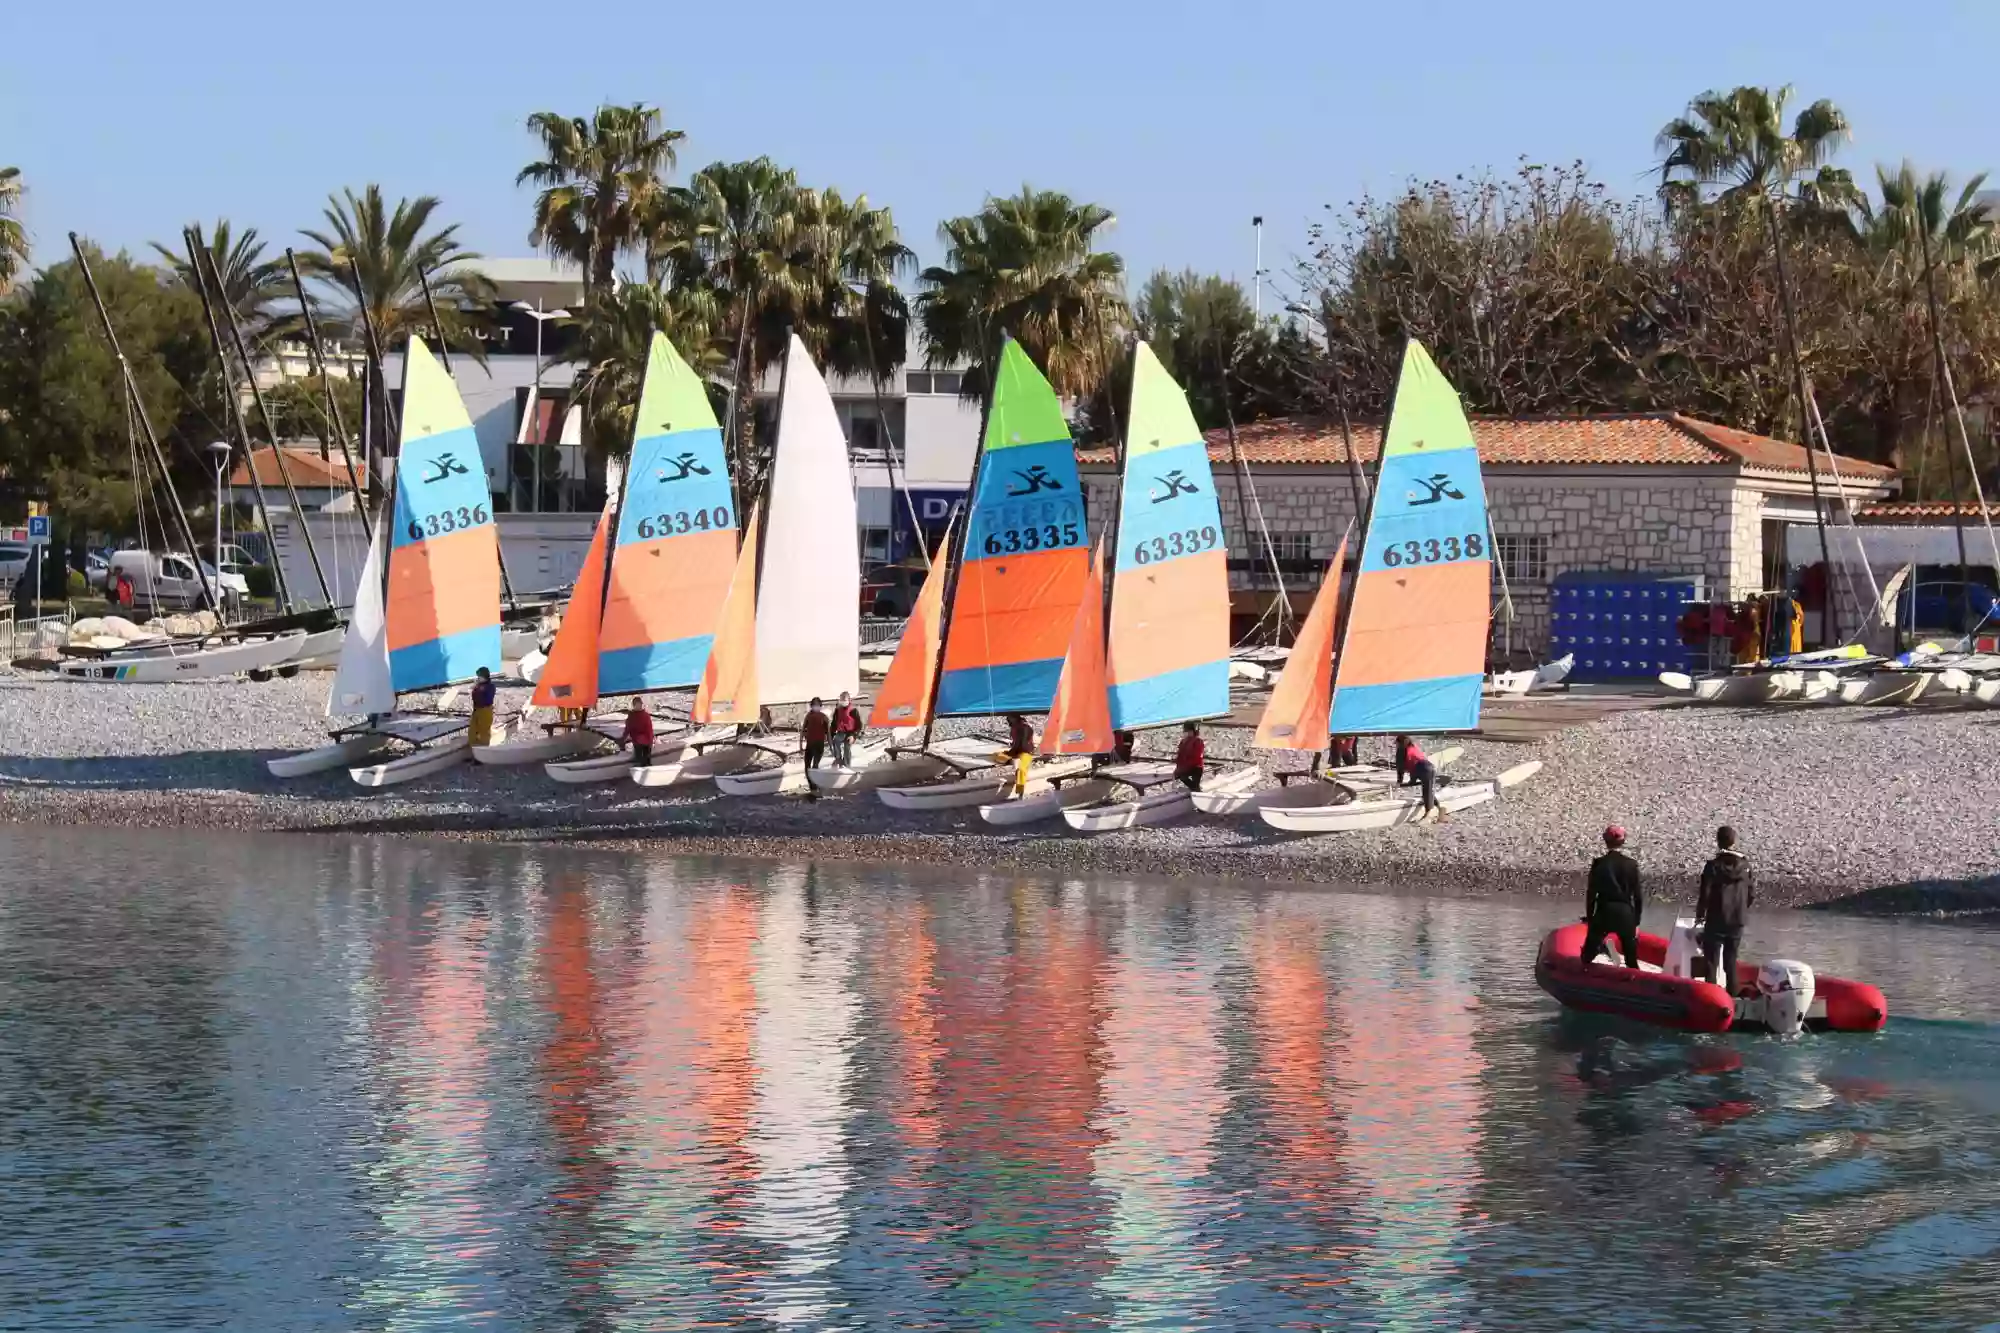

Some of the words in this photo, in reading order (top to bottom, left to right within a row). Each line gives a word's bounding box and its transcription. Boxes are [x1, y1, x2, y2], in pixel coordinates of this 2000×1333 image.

[34, 519, 43, 533] P
[408, 503, 488, 540] 63336
[638, 506, 728, 538] 63340
[984, 523, 1079, 554] 63335
[1135, 526, 1216, 564] 63339
[1383, 533, 1482, 566] 63338
